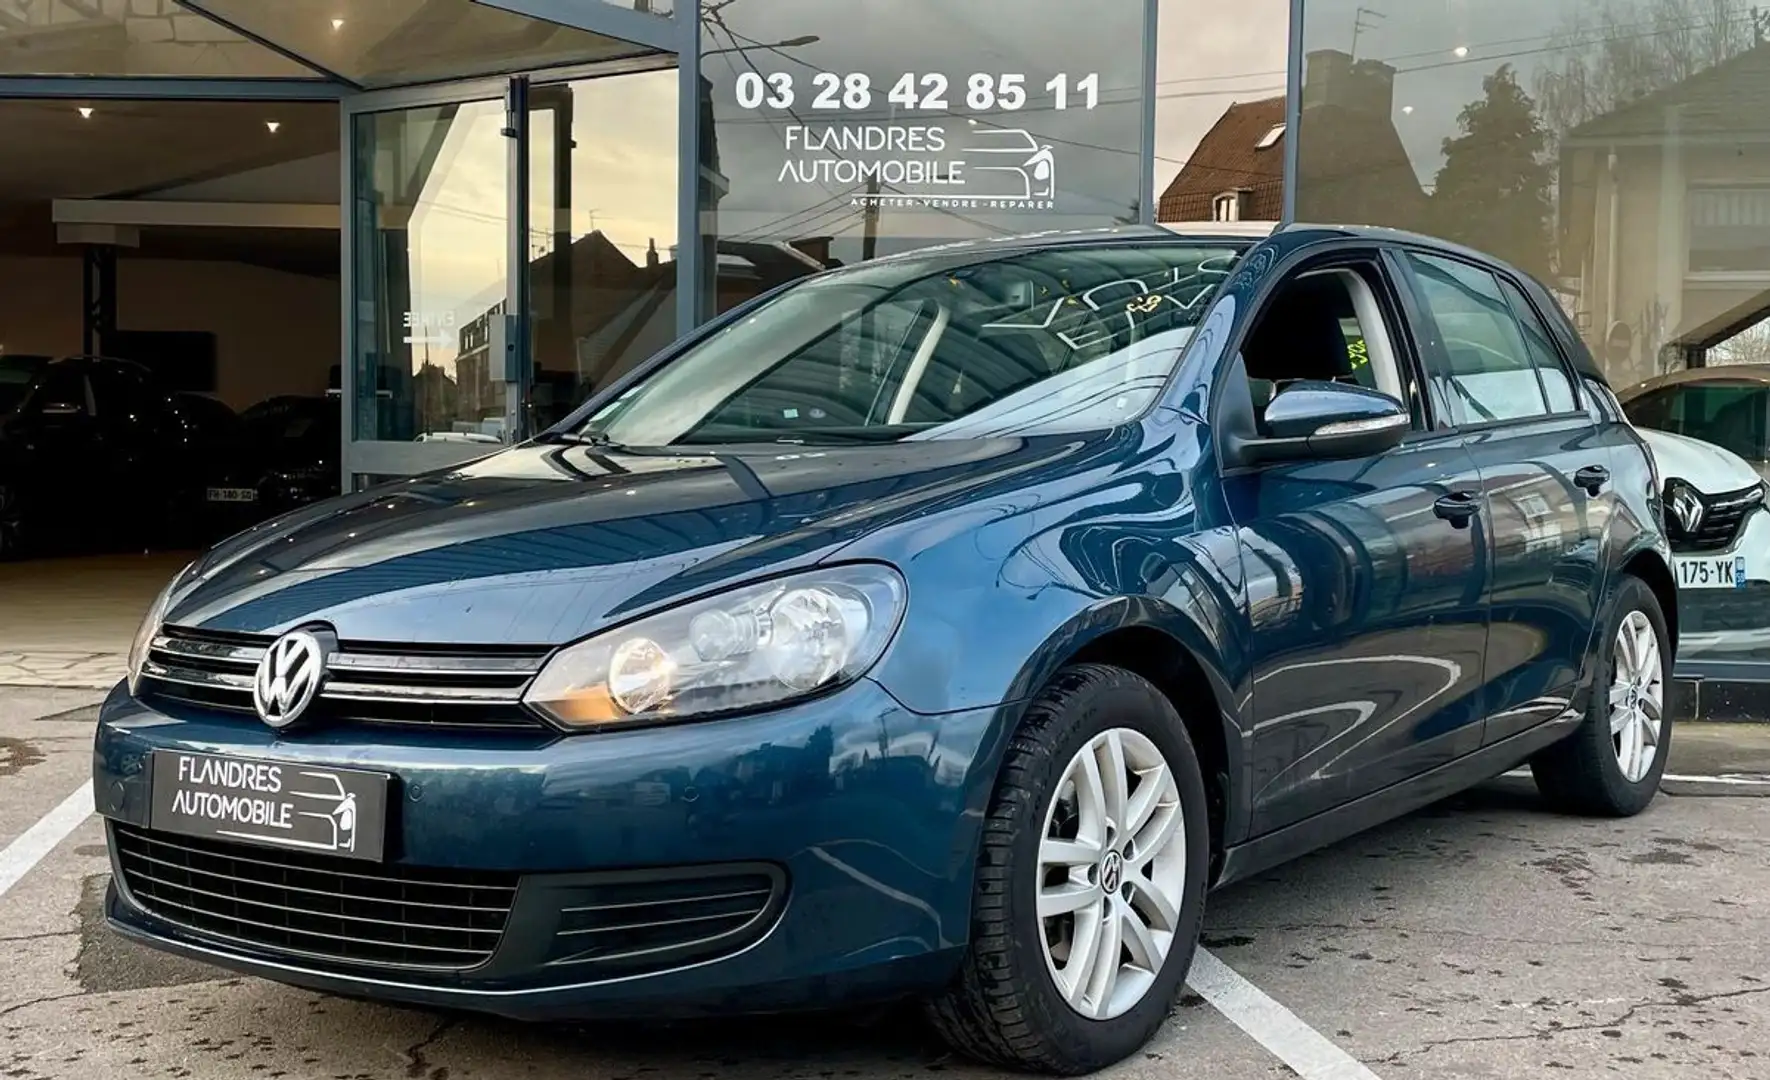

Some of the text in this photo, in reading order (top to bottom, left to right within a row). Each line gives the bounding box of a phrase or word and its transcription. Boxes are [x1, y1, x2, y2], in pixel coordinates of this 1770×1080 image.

[736, 72, 1099, 111] 03 28 42 85 11
[785, 126, 946, 153] FLANDRES
[777, 159, 966, 185] AUTOMOBILE
[178, 756, 282, 793] FLANDRES
[172, 789, 294, 829] AUTOMOBILE
